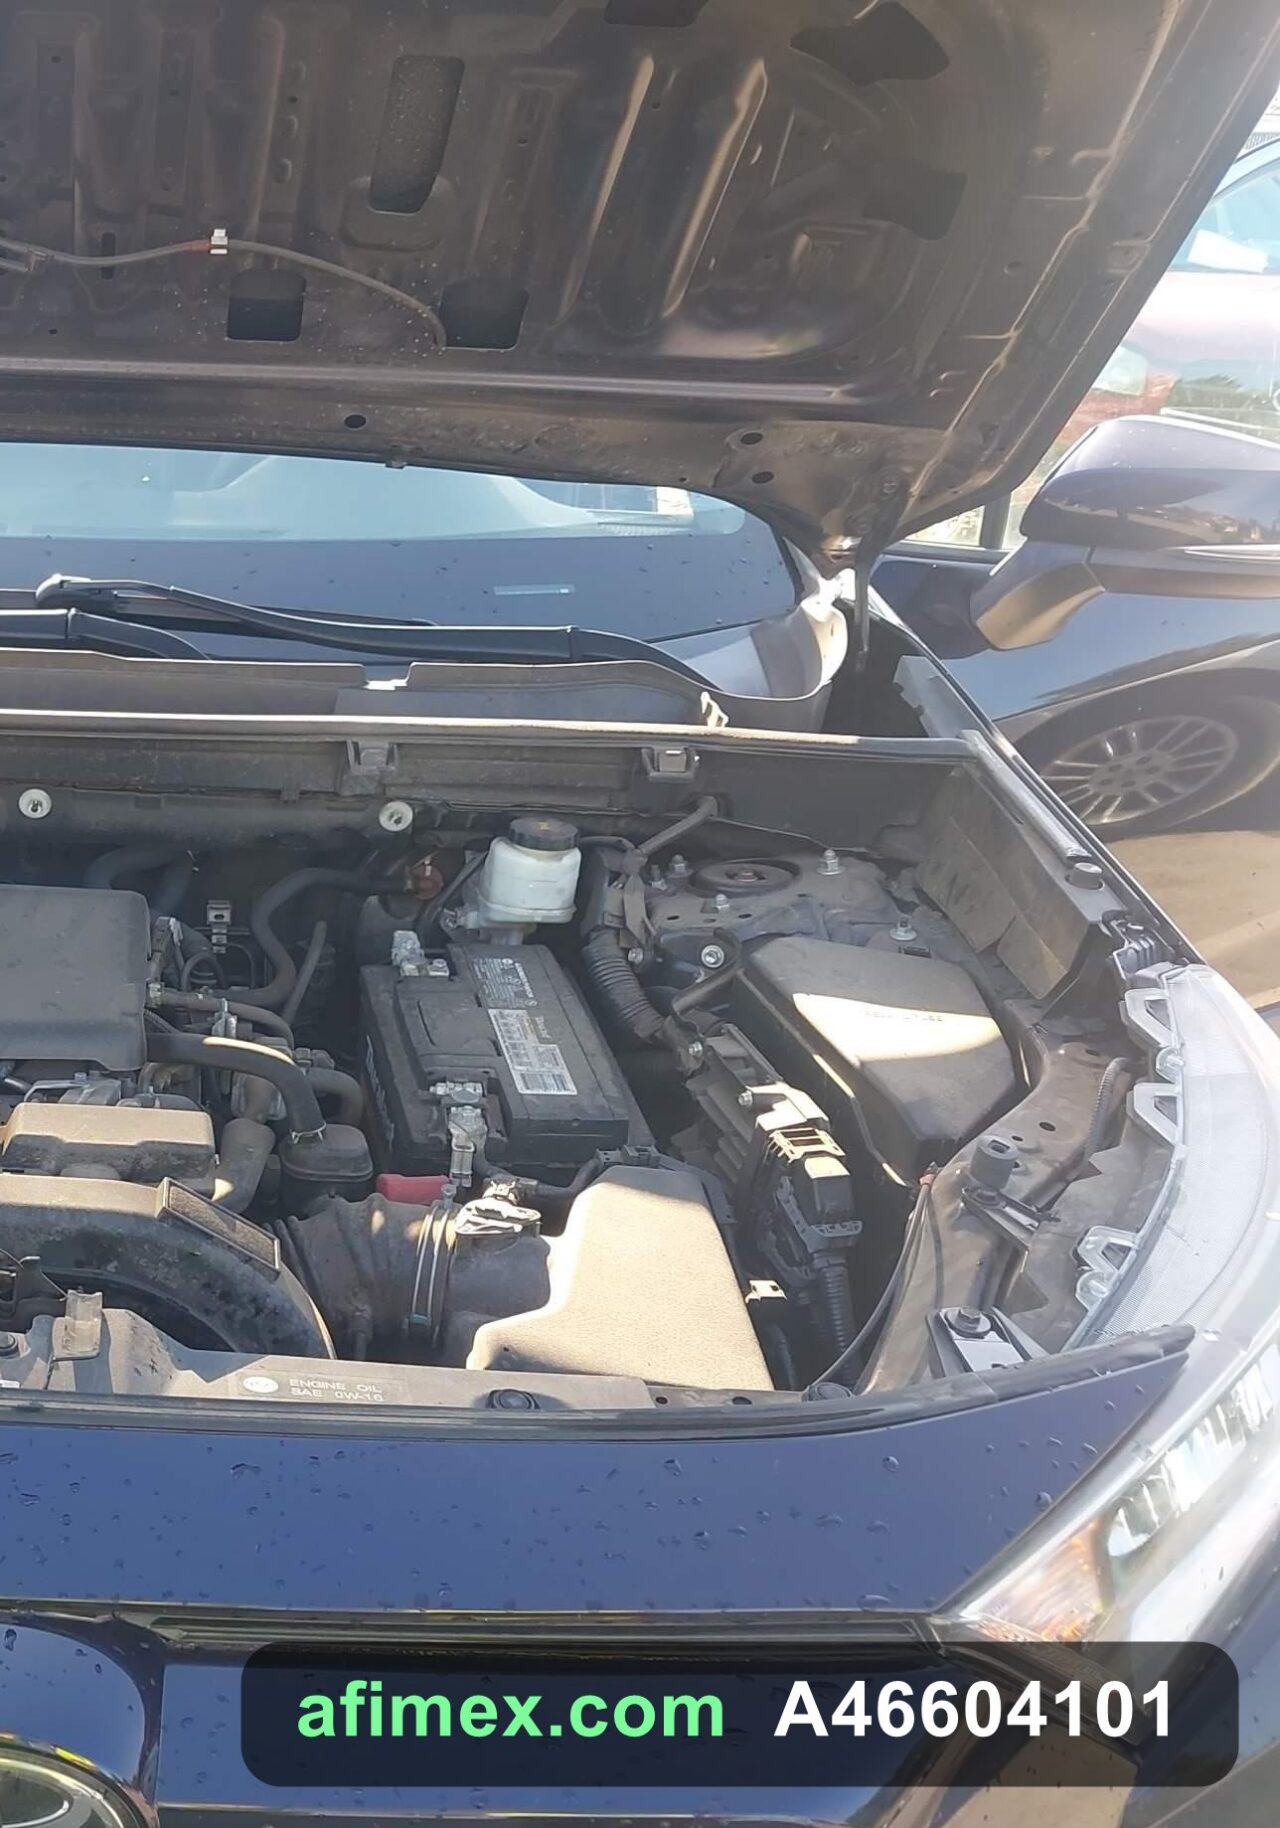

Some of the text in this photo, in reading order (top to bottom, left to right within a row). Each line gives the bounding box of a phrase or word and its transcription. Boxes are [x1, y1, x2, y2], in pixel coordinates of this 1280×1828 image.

[289, 1378, 383, 1394] ENGINE OIL
[290, 1387, 323, 1398] SAE
